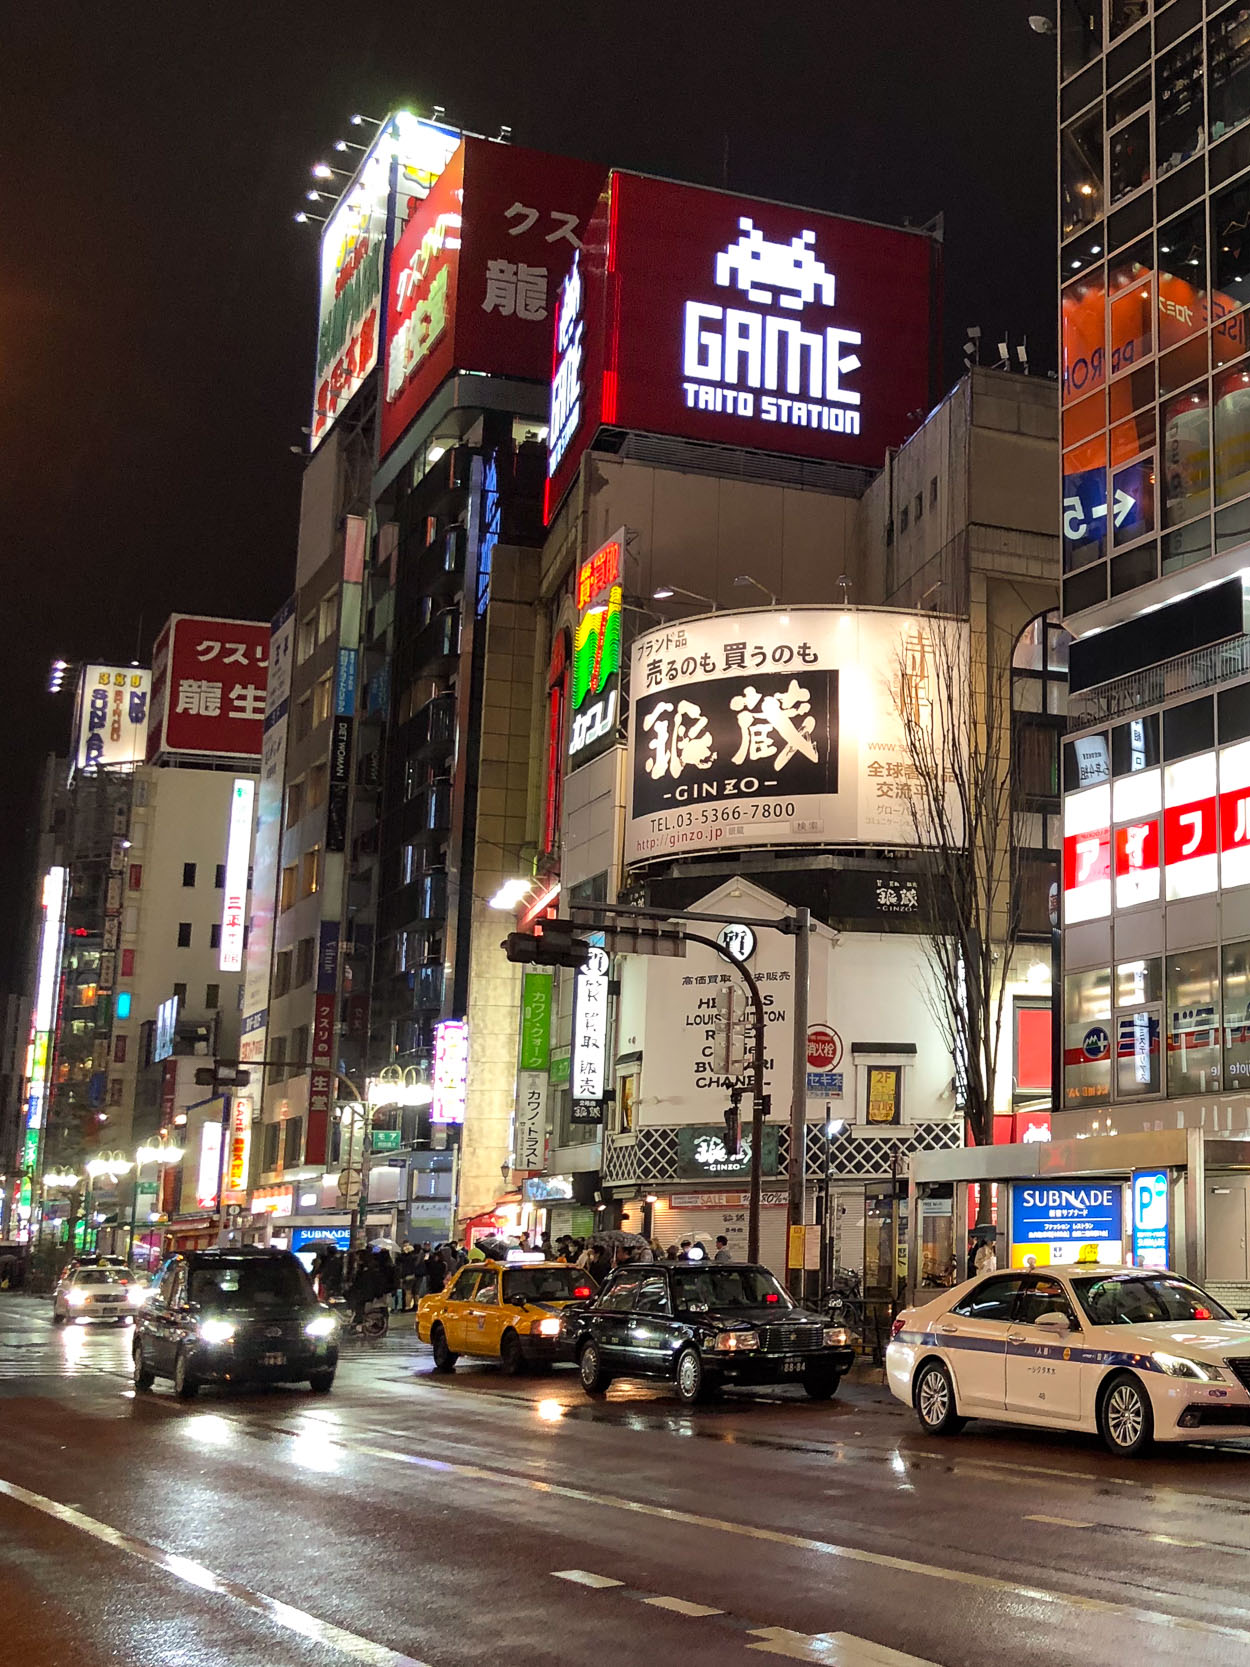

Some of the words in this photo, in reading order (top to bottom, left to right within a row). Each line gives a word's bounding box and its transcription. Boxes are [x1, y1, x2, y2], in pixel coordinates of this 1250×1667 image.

[683, 299, 861, 405] GAME
[683, 382, 754, 417] TAITO
[761, 396, 861, 435] STATION
[636, 825, 723, 852] http://ginzo.jp
[682, 974, 732, 987] 高価買取
[876, 1072, 892, 1084] 2F
[1022, 1190, 1113, 1209] SUBNADE
[1139, 1186, 1153, 1223] P
